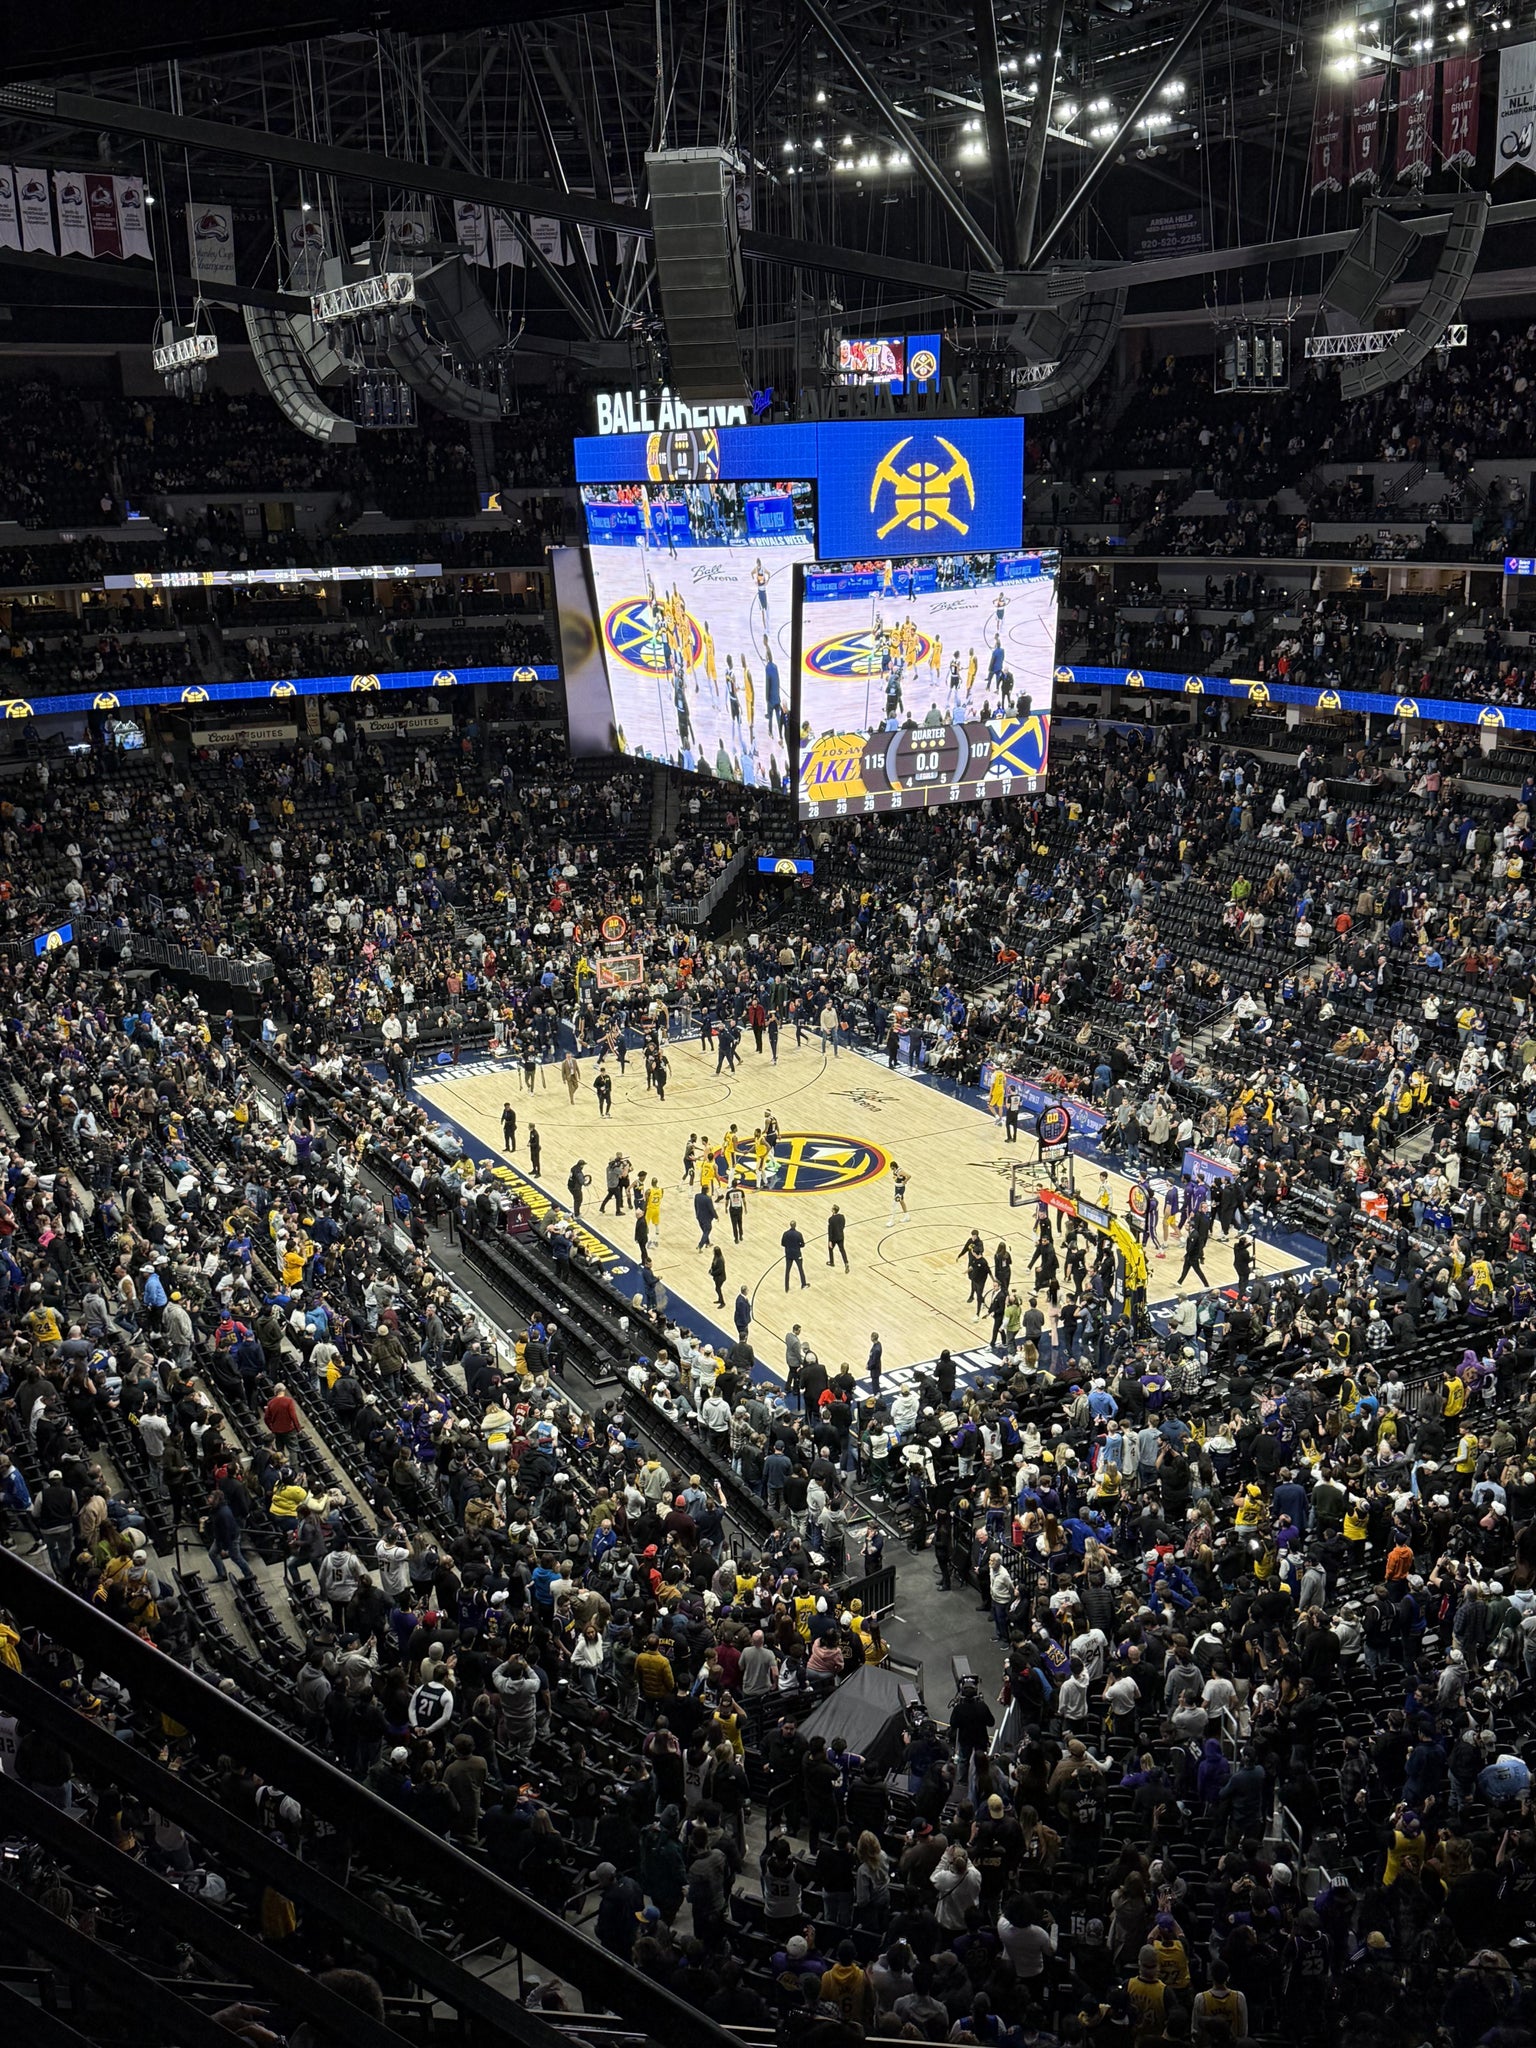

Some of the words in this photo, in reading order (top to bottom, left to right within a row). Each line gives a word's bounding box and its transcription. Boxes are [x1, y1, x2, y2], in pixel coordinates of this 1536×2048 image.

[1451, 100, 1472, 113] GRANT
[1509, 96, 1530, 109] NLL
[1357, 121, 1377, 134] PROUT
[1451, 116, 1468, 140] 24
[1362, 136, 1370, 158] 9
[1405, 128, 1424, 152] 22
[1323, 146, 1331, 167] 6
[1150, 216, 1174, 226] ARENA
[1175, 214, 1193, 223] HELP
[596, 390, 654, 435] BALL
[658, 386, 747, 431] ARENA
[756, 536, 785, 546] RIVALS
[786, 534, 809, 545] WEEK
[691, 564, 726, 584] Ball
[707, 573, 738, 582] Arena
[369, 720, 395, 732] Coors
[408, 718, 439, 727] SUITES
[207, 732, 236, 743] Coors
[250, 729, 283, 739] SUITES
[912, 728, 946, 741] QUARTER
[822, 747, 838, 757] LOS
[971, 742, 990, 758] 107
[865, 753, 885, 770] 115
[916, 752, 939, 771] 0.0
[906, 777, 913, 787] 4
[940, 773, 947, 784] 5
[949, 790, 960, 801] 37
[976, 786, 986, 797] 34
[1002, 784, 1011, 794] 17
[1028, 780, 1037, 791] 19
[809, 806, 820, 818] 28
[836, 803, 847, 814] 29
[864, 800, 875, 811] 29
[891, 796, 902, 807] 29
[37, 1321, 50, 1333] 24
[1281, 1431, 1292, 1442] 23
[1381, 1618, 1394, 1633] 27
[1086, 1645, 1101, 1664] 24
[418, 1698, 434, 1717] 21
[686, 1772, 701, 1786] 23
[1079, 1807, 1097, 1824] 27
[314, 1820, 337, 1838] 32
[771, 1882, 790, 1897] 32
[1071, 1916, 1086, 1935] 15
[1301, 1957, 1325, 1977] 23
[841, 1995, 853, 2013] 6
